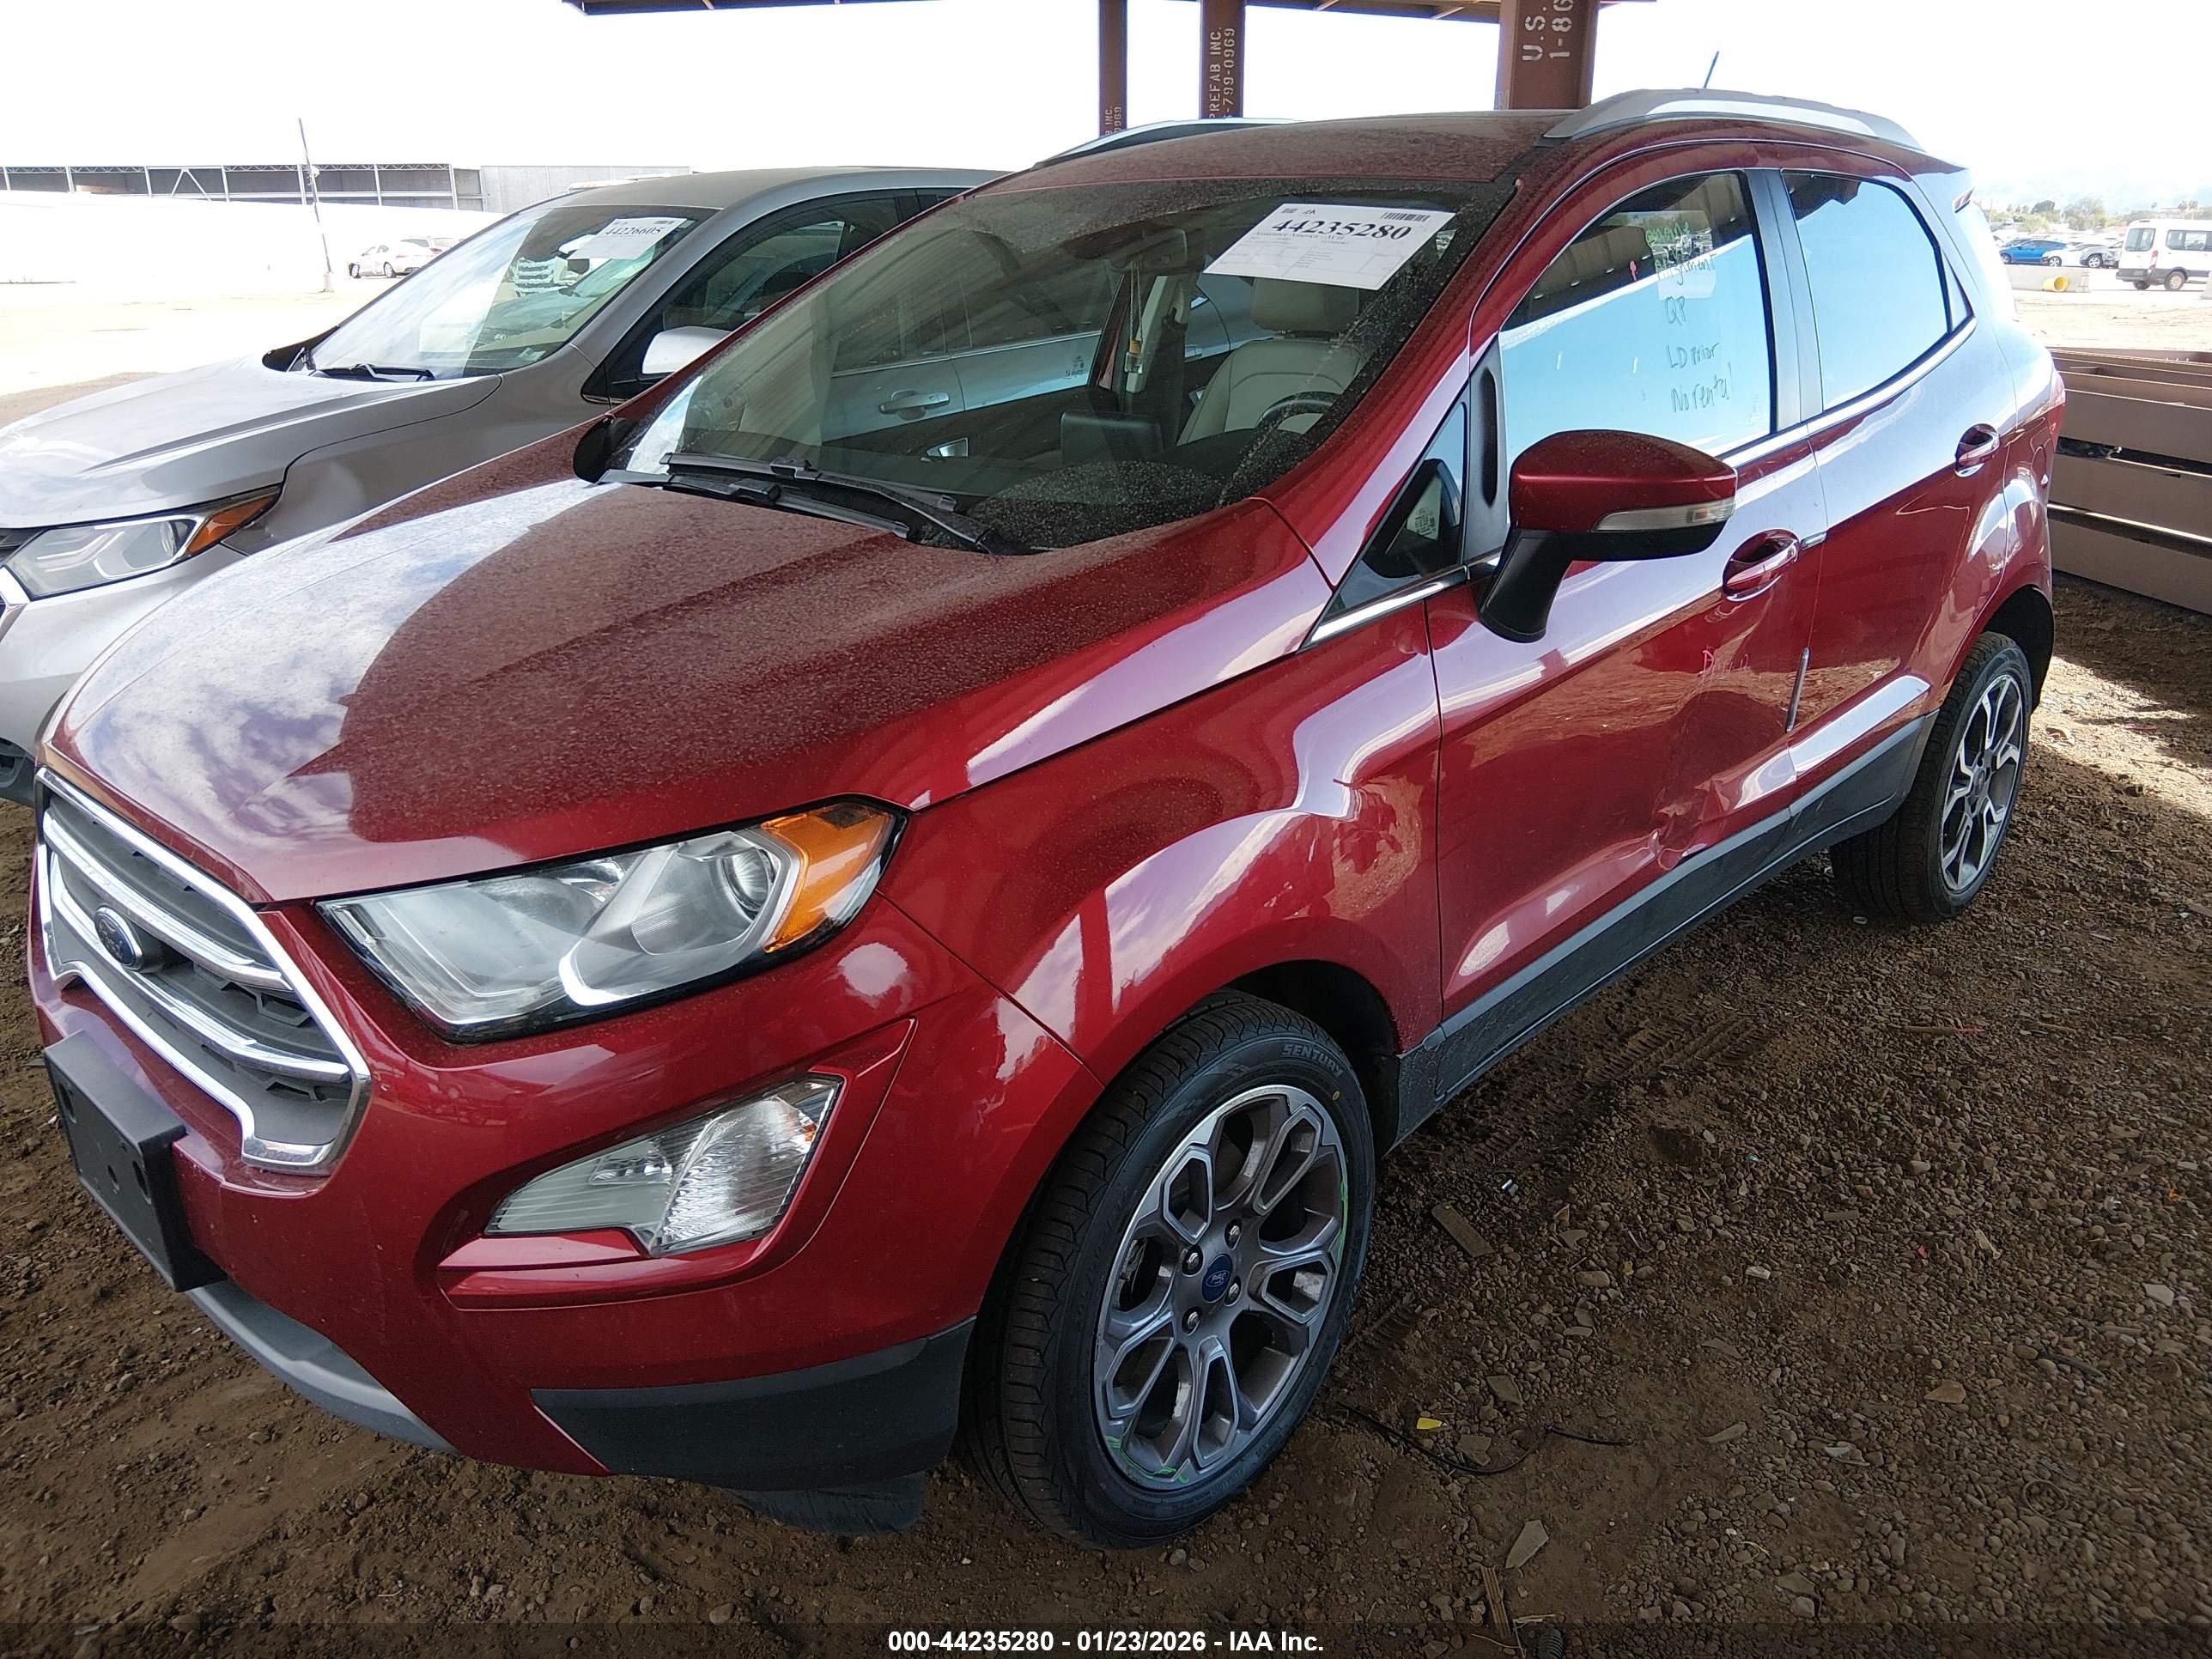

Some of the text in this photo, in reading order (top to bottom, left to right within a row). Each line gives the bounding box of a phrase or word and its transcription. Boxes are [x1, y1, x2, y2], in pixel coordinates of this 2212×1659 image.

[1209, 27, 1222, 56] INC.
[1522, 6, 1547, 61] U.S.
[1104, 105, 1114, 125] INC.
[1272, 219, 1412, 240] 44235280
[1282, 1043, 1344, 1078] SENTURY
